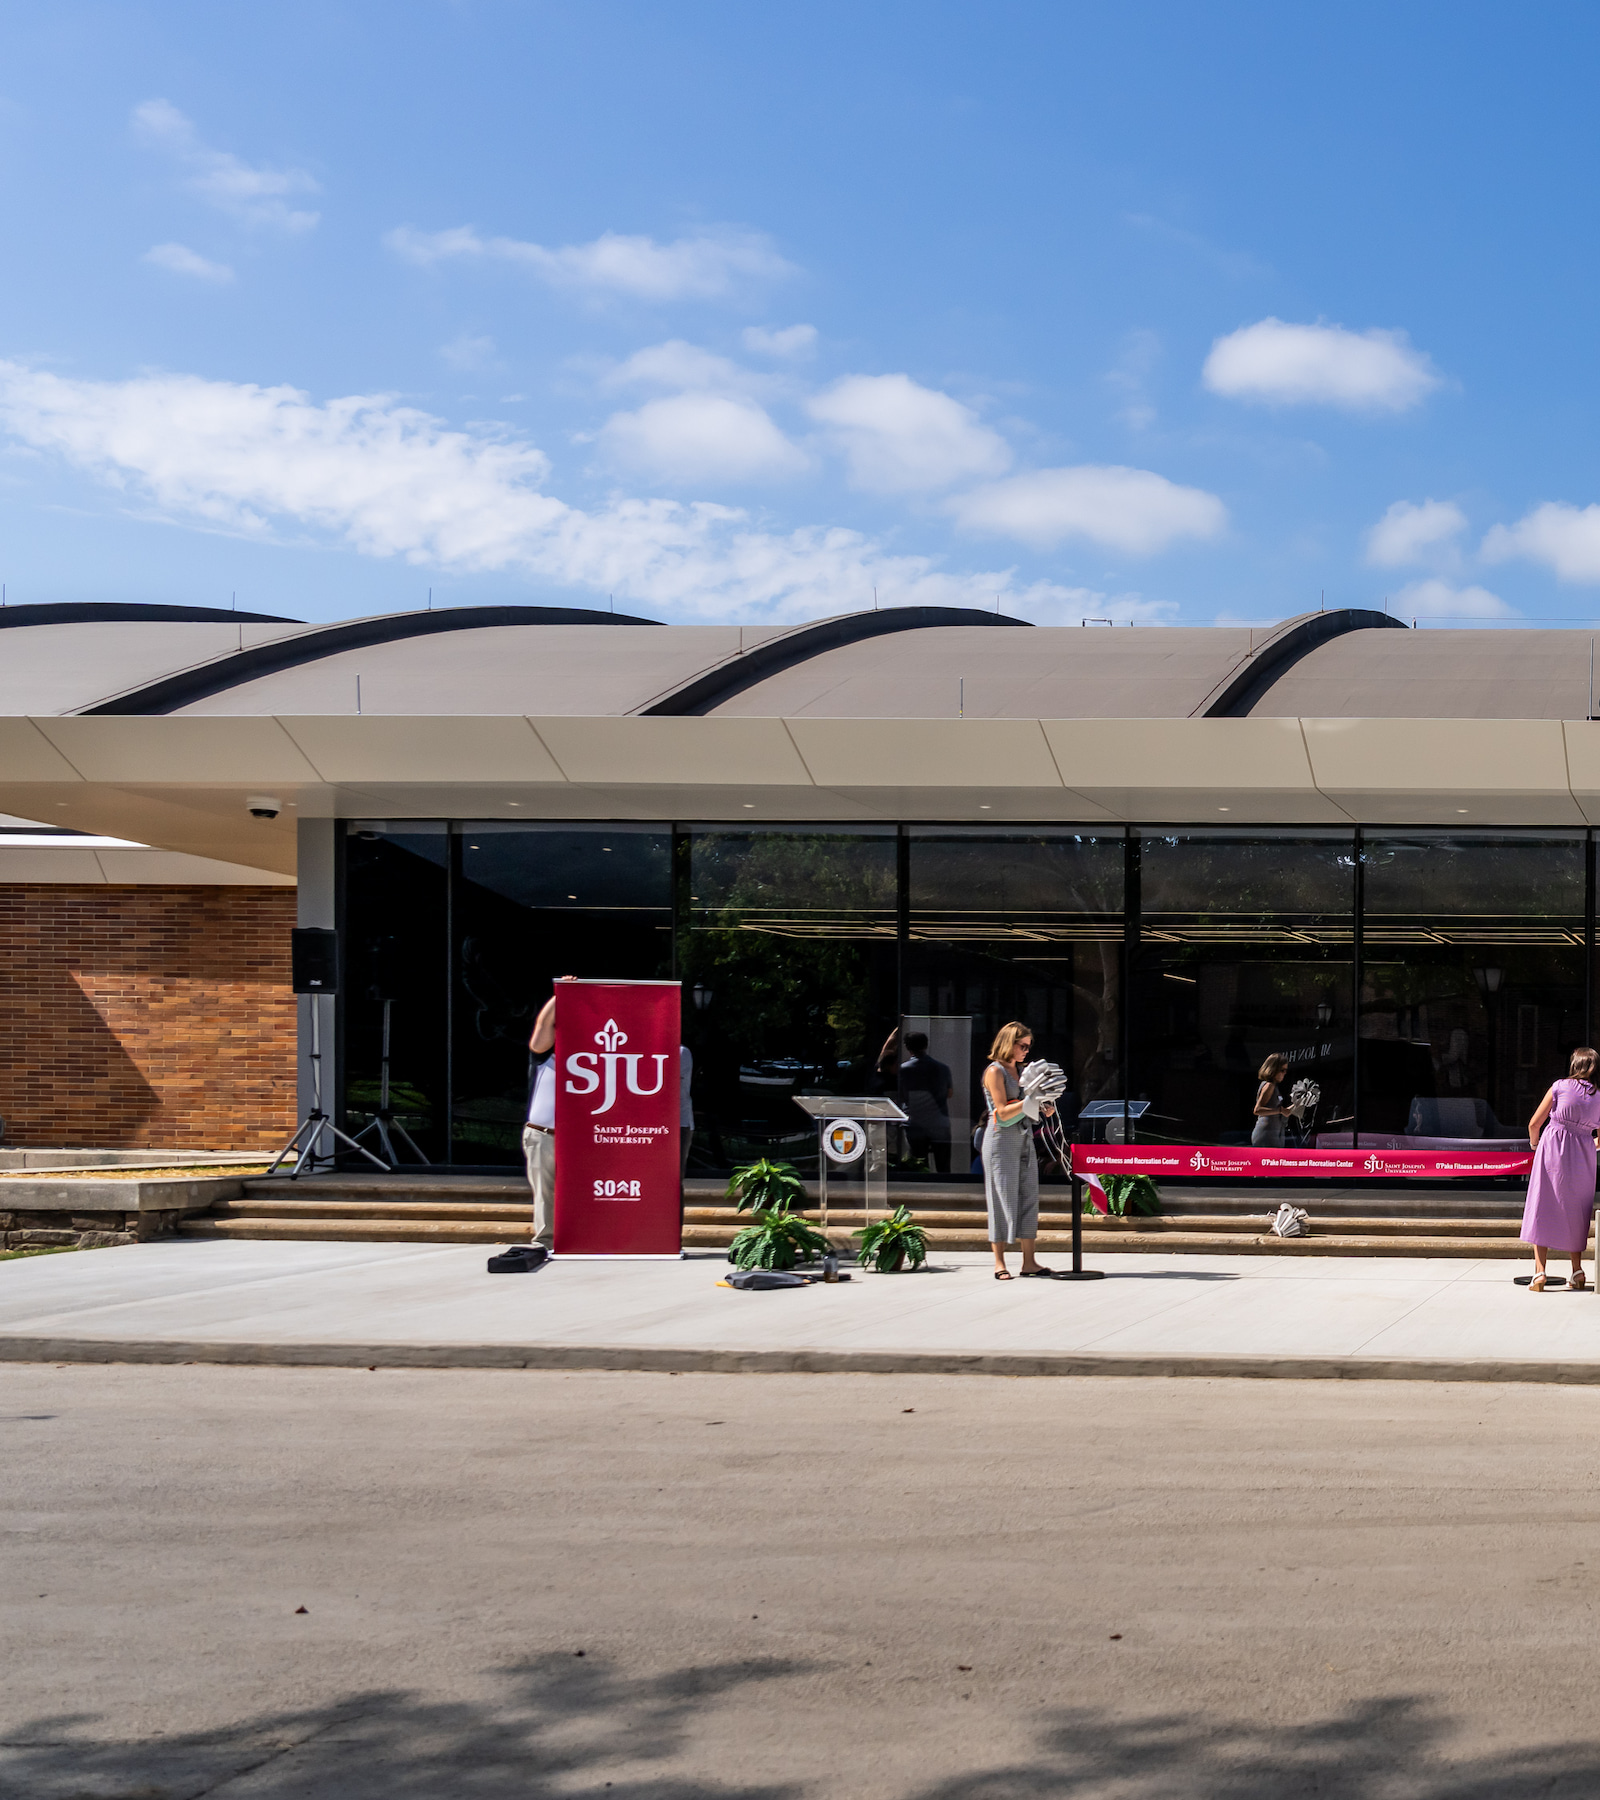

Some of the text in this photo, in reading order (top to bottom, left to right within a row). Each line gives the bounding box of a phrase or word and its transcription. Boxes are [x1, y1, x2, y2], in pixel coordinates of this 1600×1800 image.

[565, 1052, 669, 1115] SJU
[594, 1124, 669, 1136] SAINT JOSEPH'S
[594, 1134, 654, 1144] UNIVERSITY
[1086, 1156, 1104, 1164] O'Pake
[1134, 1157, 1161, 1165] Recreation
[1190, 1157, 1210, 1171] SJU
[1364, 1160, 1384, 1173] SJU
